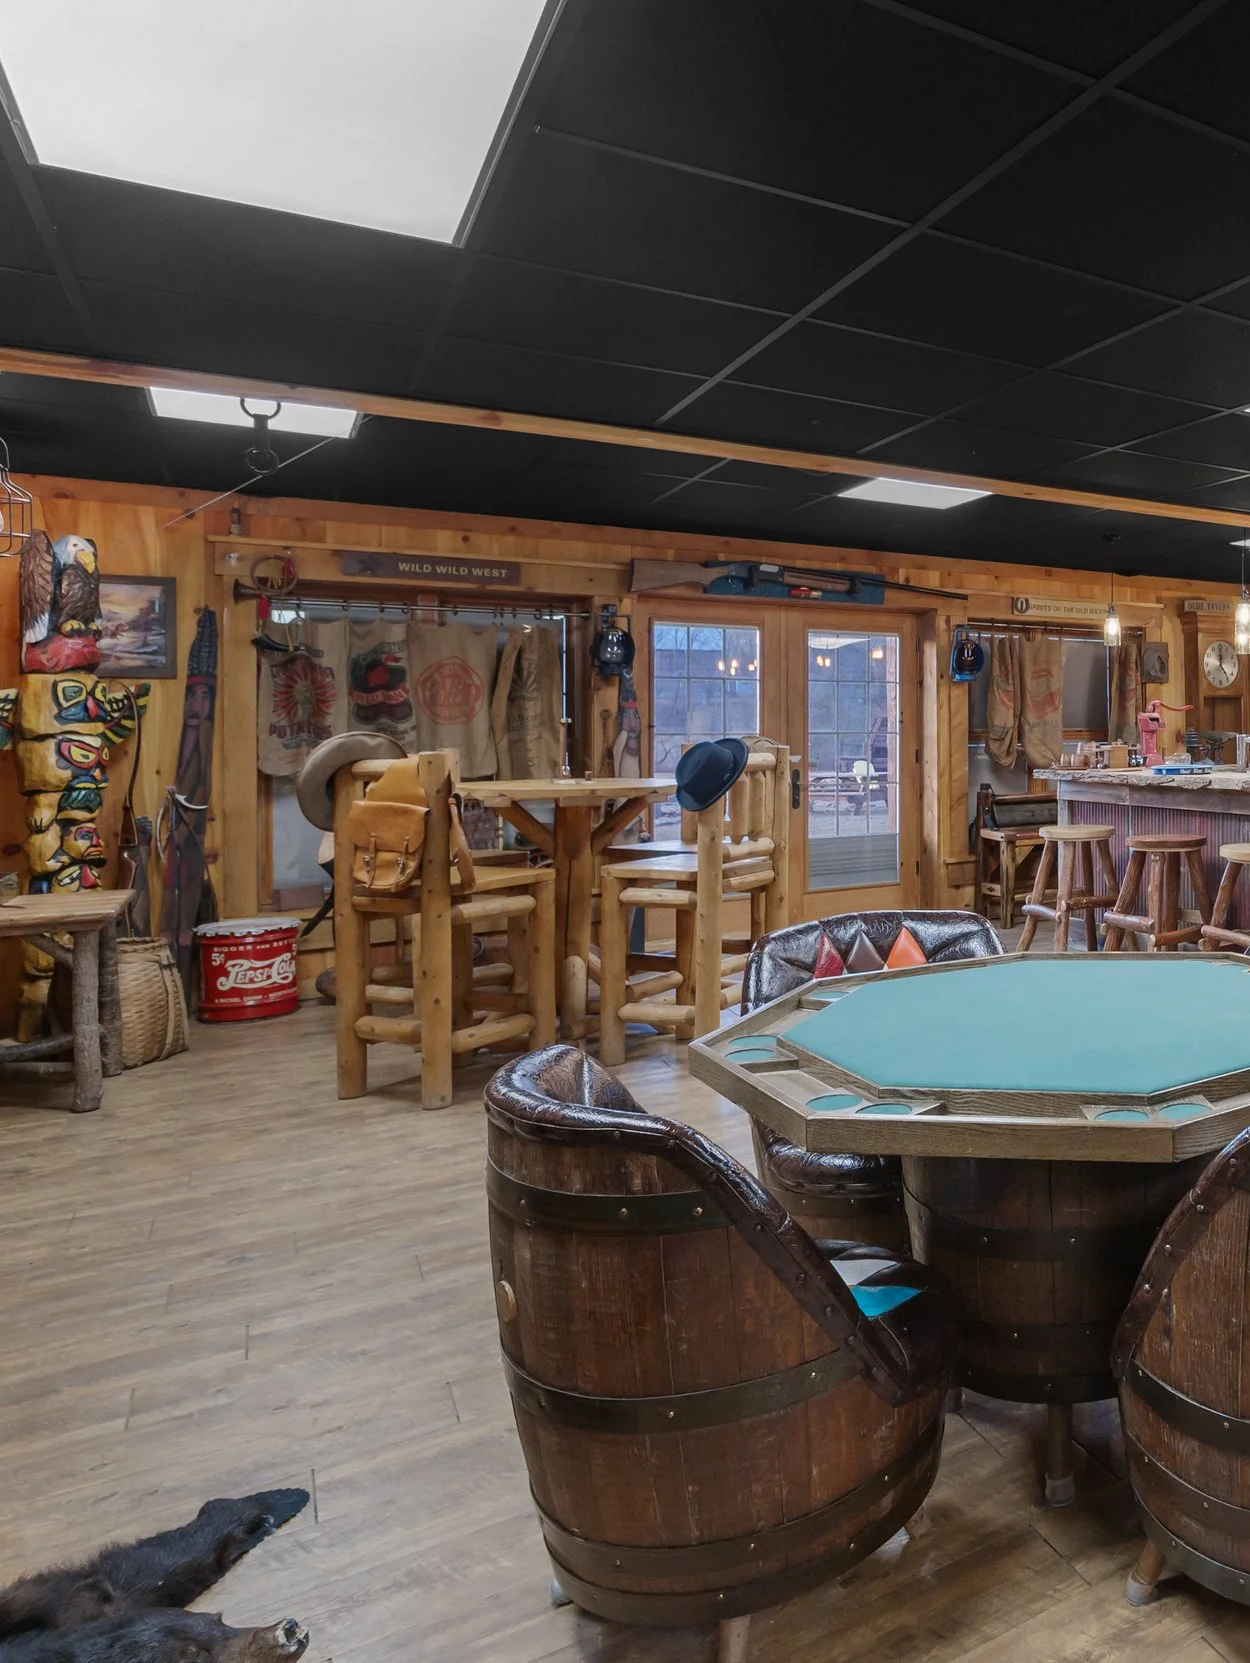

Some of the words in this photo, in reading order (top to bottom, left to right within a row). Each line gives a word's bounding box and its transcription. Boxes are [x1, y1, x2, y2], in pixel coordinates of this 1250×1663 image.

[398, 561, 432, 573] WILD
[436, 564, 468, 575] WILD
[472, 567, 508, 578] WEST
[1187, 602, 1203, 610] OLDE
[1207, 602, 1231, 611] TAVERN
[213, 944, 253, 952] BIGGER
